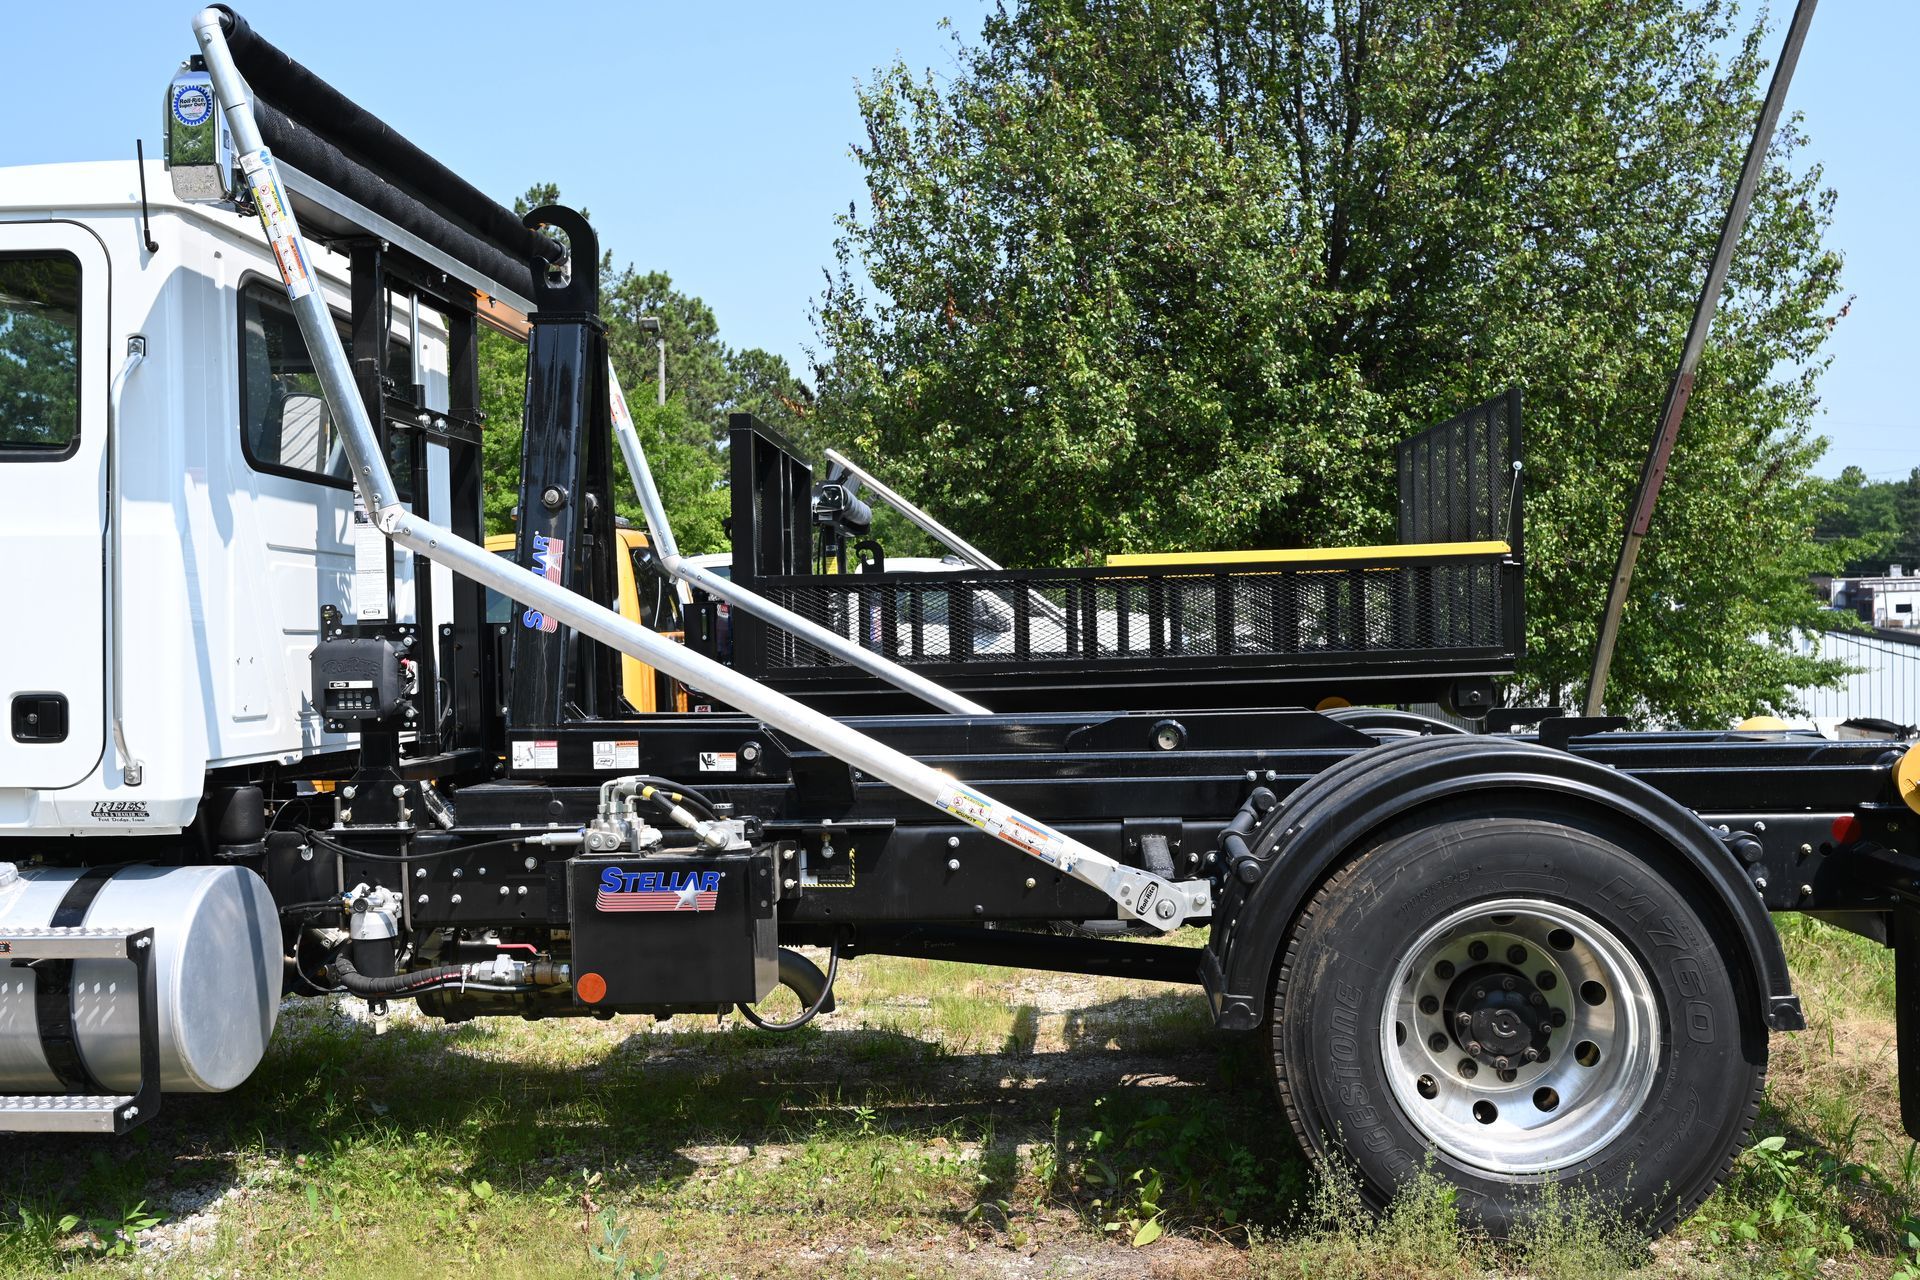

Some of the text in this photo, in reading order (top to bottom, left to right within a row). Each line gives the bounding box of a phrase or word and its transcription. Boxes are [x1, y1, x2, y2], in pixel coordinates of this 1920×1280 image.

[523, 535, 550, 630] SLAR
[93, 801, 147, 812] REES
[955, 810, 973, 821] CAUTION
[599, 866, 720, 893] STELLAR
[1596, 875, 1715, 1044] M760
[1329, 979, 1417, 1180] DGESTONE
